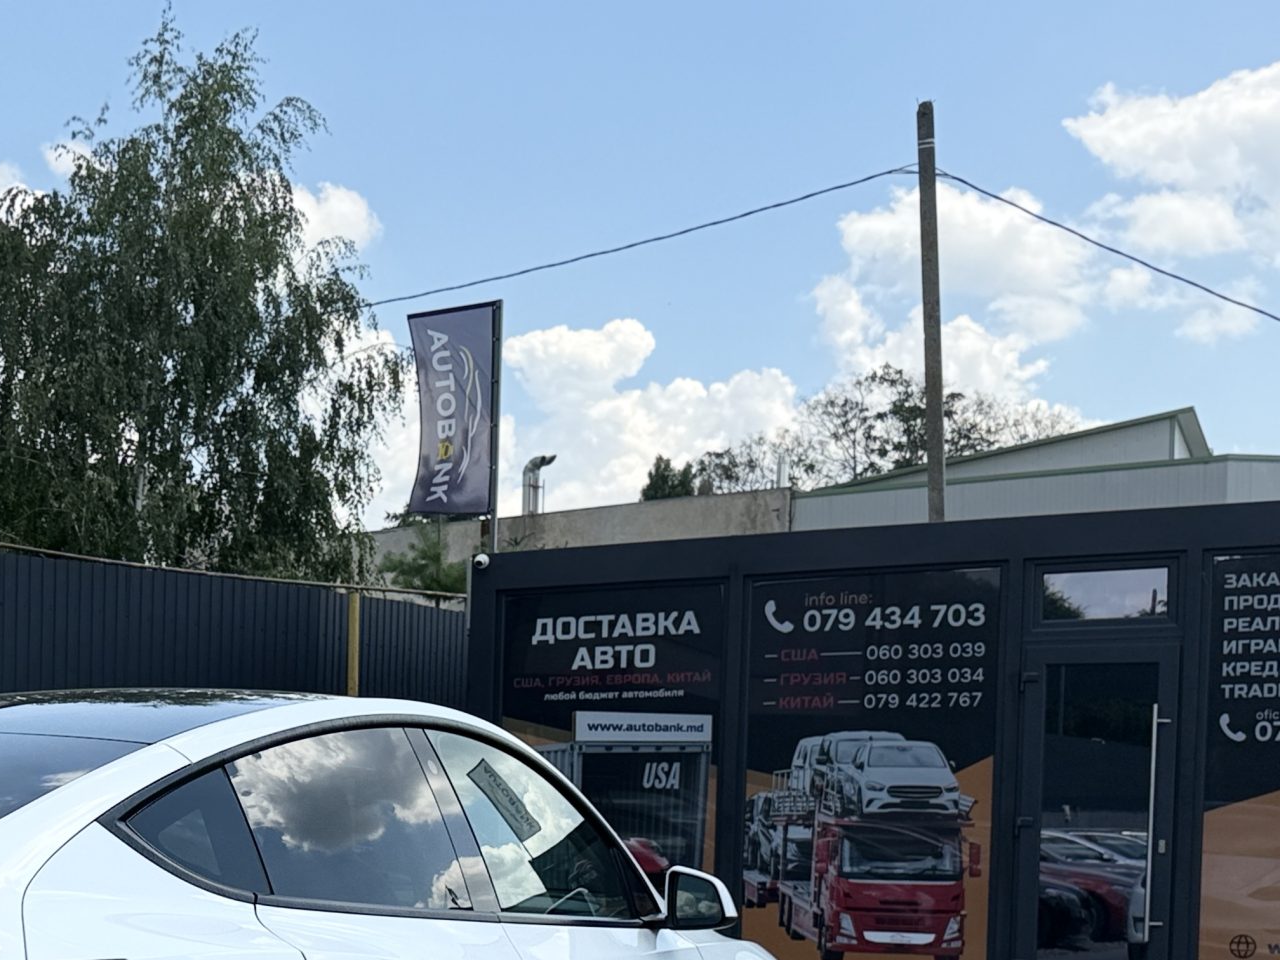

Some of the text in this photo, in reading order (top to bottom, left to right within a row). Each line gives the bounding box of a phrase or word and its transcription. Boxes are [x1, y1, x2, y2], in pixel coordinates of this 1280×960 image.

[805, 592, 873, 607] info line:
[803, 603, 986, 632] 079 434 703
[532, 611, 701, 645] ДОСТАВКА
[780, 642, 986, 661] США 060 303 039
[1222, 639, 1280, 655] ИГРА
[571, 644, 656, 670] АВТО
[666, 669, 711, 683] КИТАЙ
[779, 668, 984, 686] ГРУЗИЯ 060 303 034
[544, 688, 685, 701] любой бюджет автомобиля
[1221, 683, 1280, 699] TRAD
[779, 692, 982, 709] КИТАЙ 079 422 767
[587, 723, 704, 733] www.autobank.md
[642, 761, 681, 789] USA
